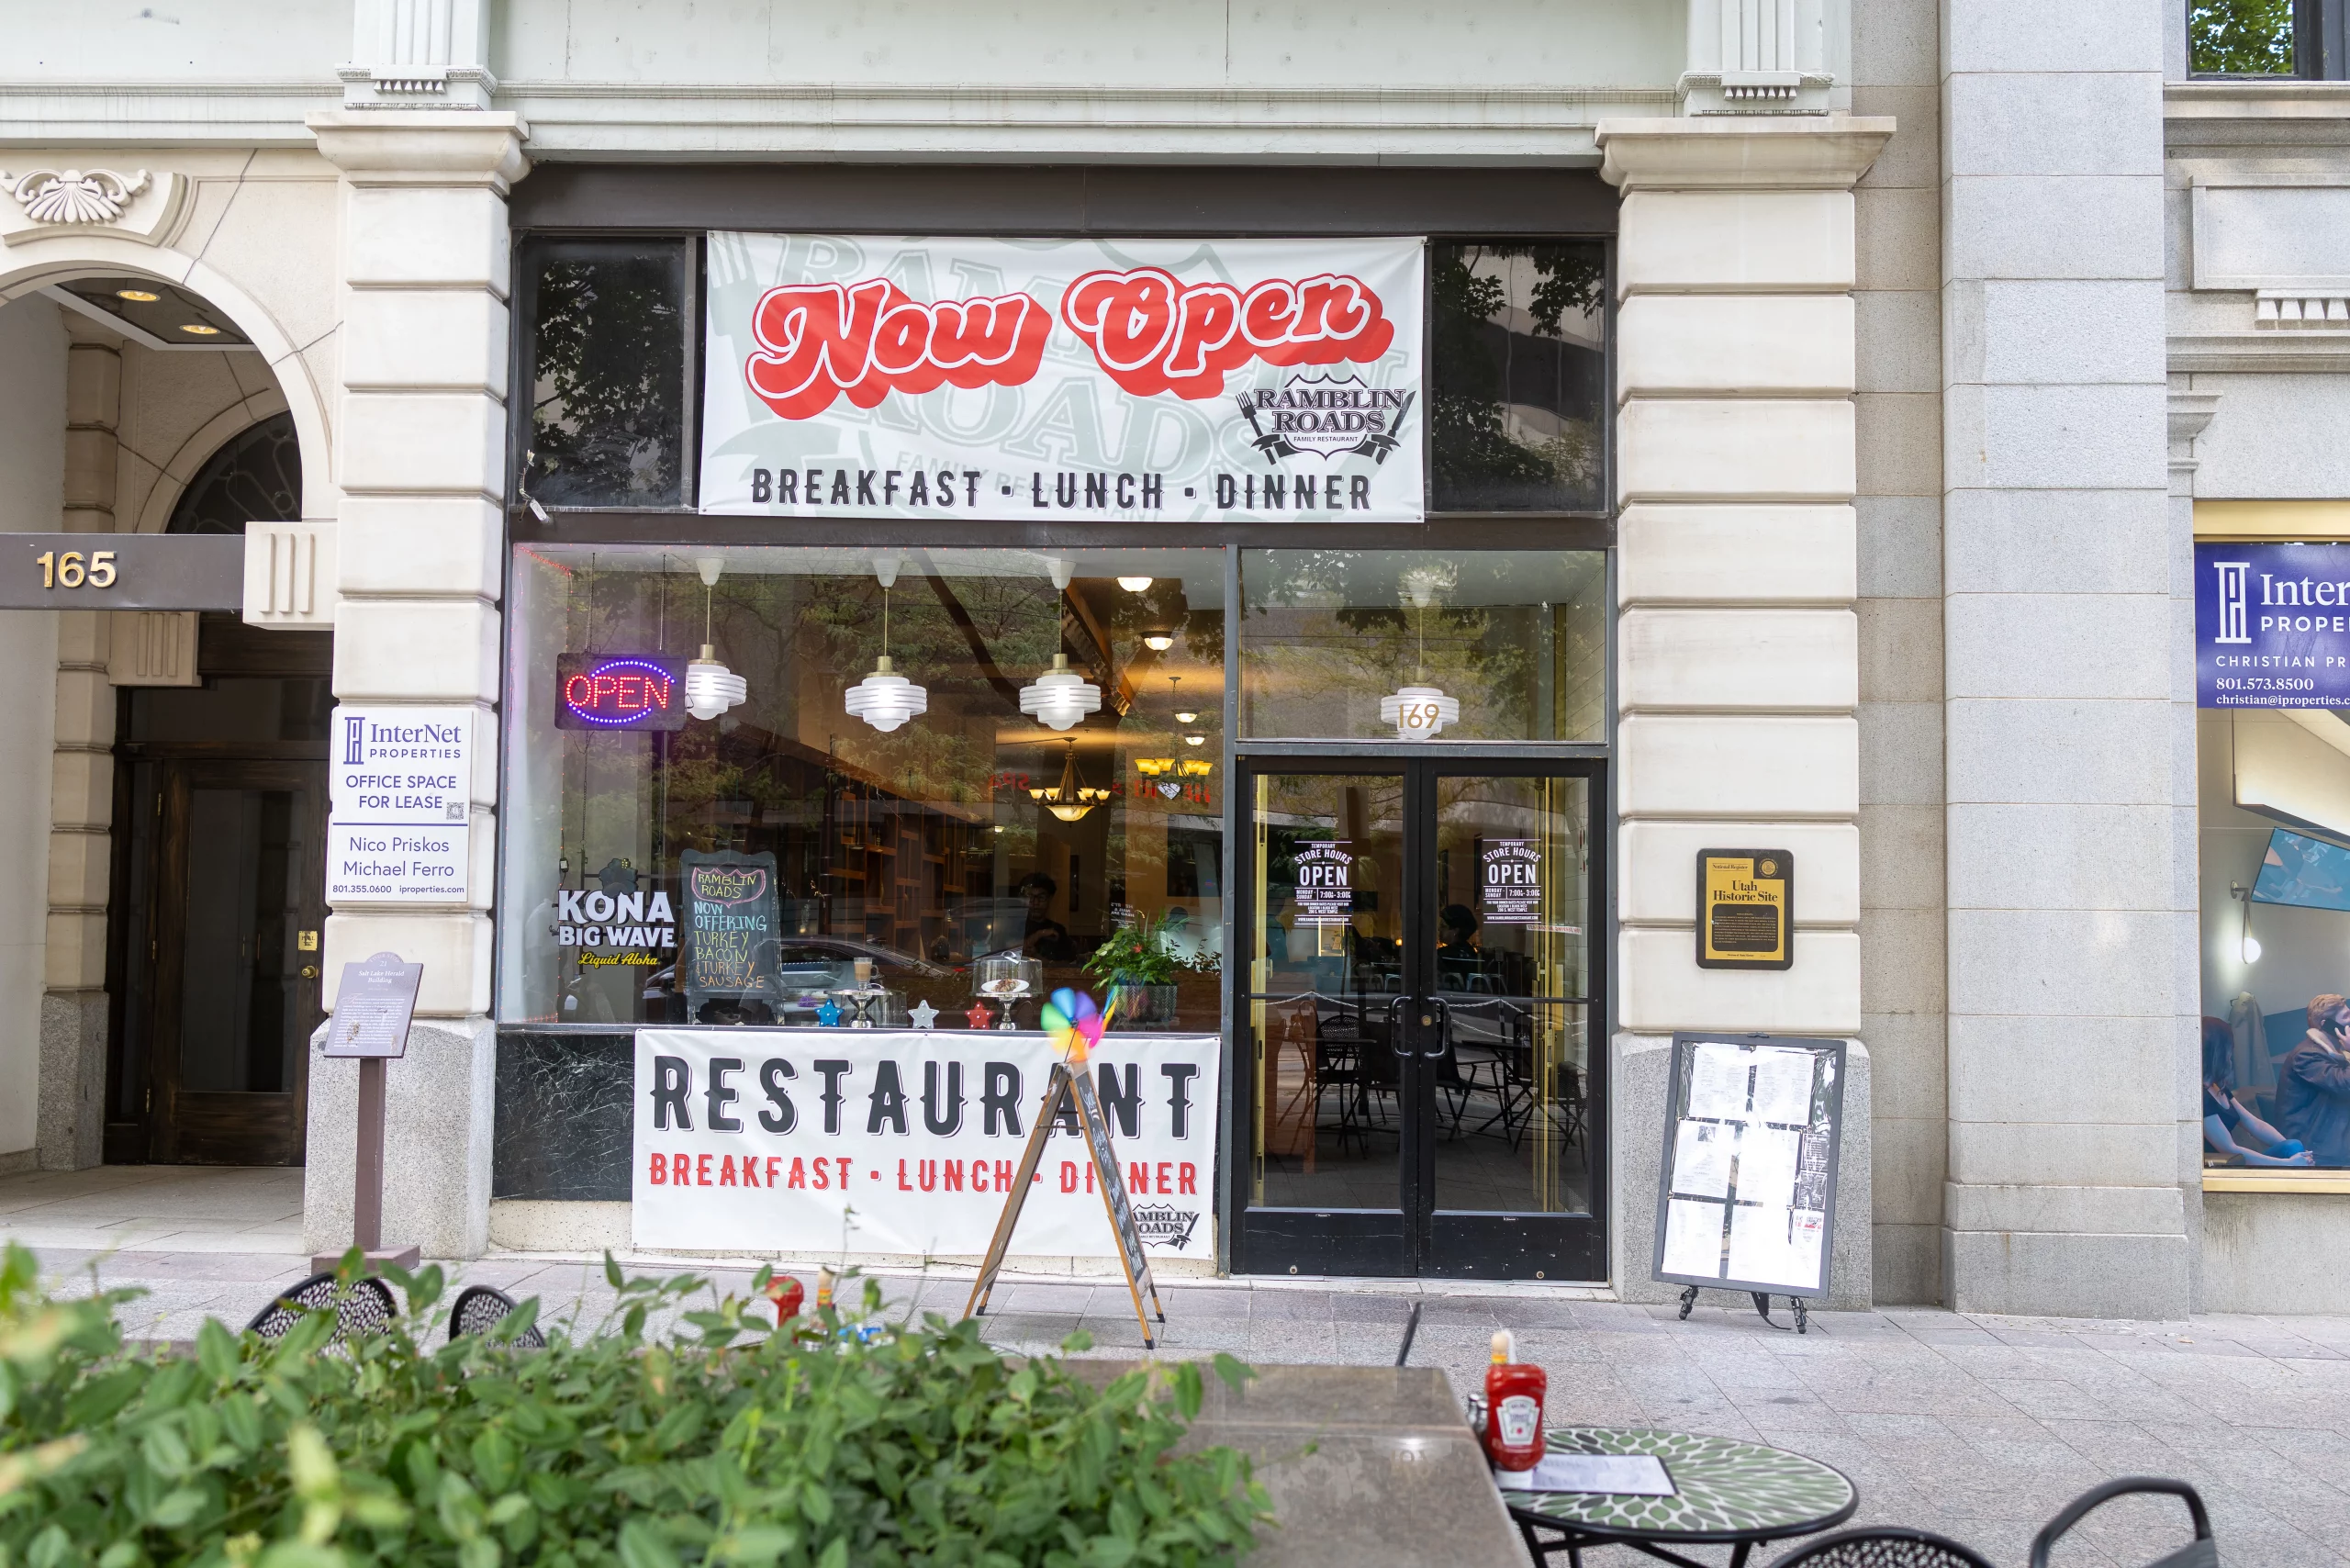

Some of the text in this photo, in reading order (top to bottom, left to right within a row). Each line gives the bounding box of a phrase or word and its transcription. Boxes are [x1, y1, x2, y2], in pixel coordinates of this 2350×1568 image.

[745, 266, 1394, 420] Now Open
[1254, 388, 1406, 410] RAMBLIN
[1272, 410, 1386, 433] ROADS
[751, 468, 1371, 511] BREAKFAST LUNCH DINNER
[37, 551, 117, 588] 165
[2261, 616, 2350, 633] PROPE
[2215, 655, 2315, 667] CHRISTIAN
[565, 675, 668, 709] OPEN
[2216, 678, 2314, 690] 801.573.8500
[1398, 703, 1439, 729] 169
[370, 723, 462, 743] InterNet
[370, 748, 461, 758] PROPERTIES
[346, 775, 457, 789] OFFICE SPACE
[359, 795, 443, 809] FOR LEASE
[350, 836, 450, 852] Nico Priskos
[1294, 848, 1352, 864] STORE HOURS
[1483, 847, 1541, 863] STORE HOURS
[343, 860, 454, 877] Michael Ferro
[1300, 866, 1348, 886] OPEN
[1488, 864, 1536, 884] OPEN
[698, 874, 756, 886] RAMBLIN
[1732, 880, 1757, 891] Utah
[332, 885, 464, 894] 801.355.0600 iproperties.com
[701, 885, 743, 899] ROADS
[1713, 890, 1778, 902] Historic Site
[557, 890, 676, 924] KONA
[694, 901, 723, 915] NOW
[694, 915, 767, 932] OFFERING
[558, 925, 676, 947] BIG WAVE
[694, 931, 749, 950] TURKEY
[577, 952, 621, 969] Liquid
[694, 946, 748, 963] BACON
[699, 976, 765, 989] SAUSAGE
[649, 1152, 1198, 1195] BREAKFAST LUNCH DINER
[1132, 1211, 1195, 1223] AMBLIN
[1137, 1222, 1184, 1235] OADS
